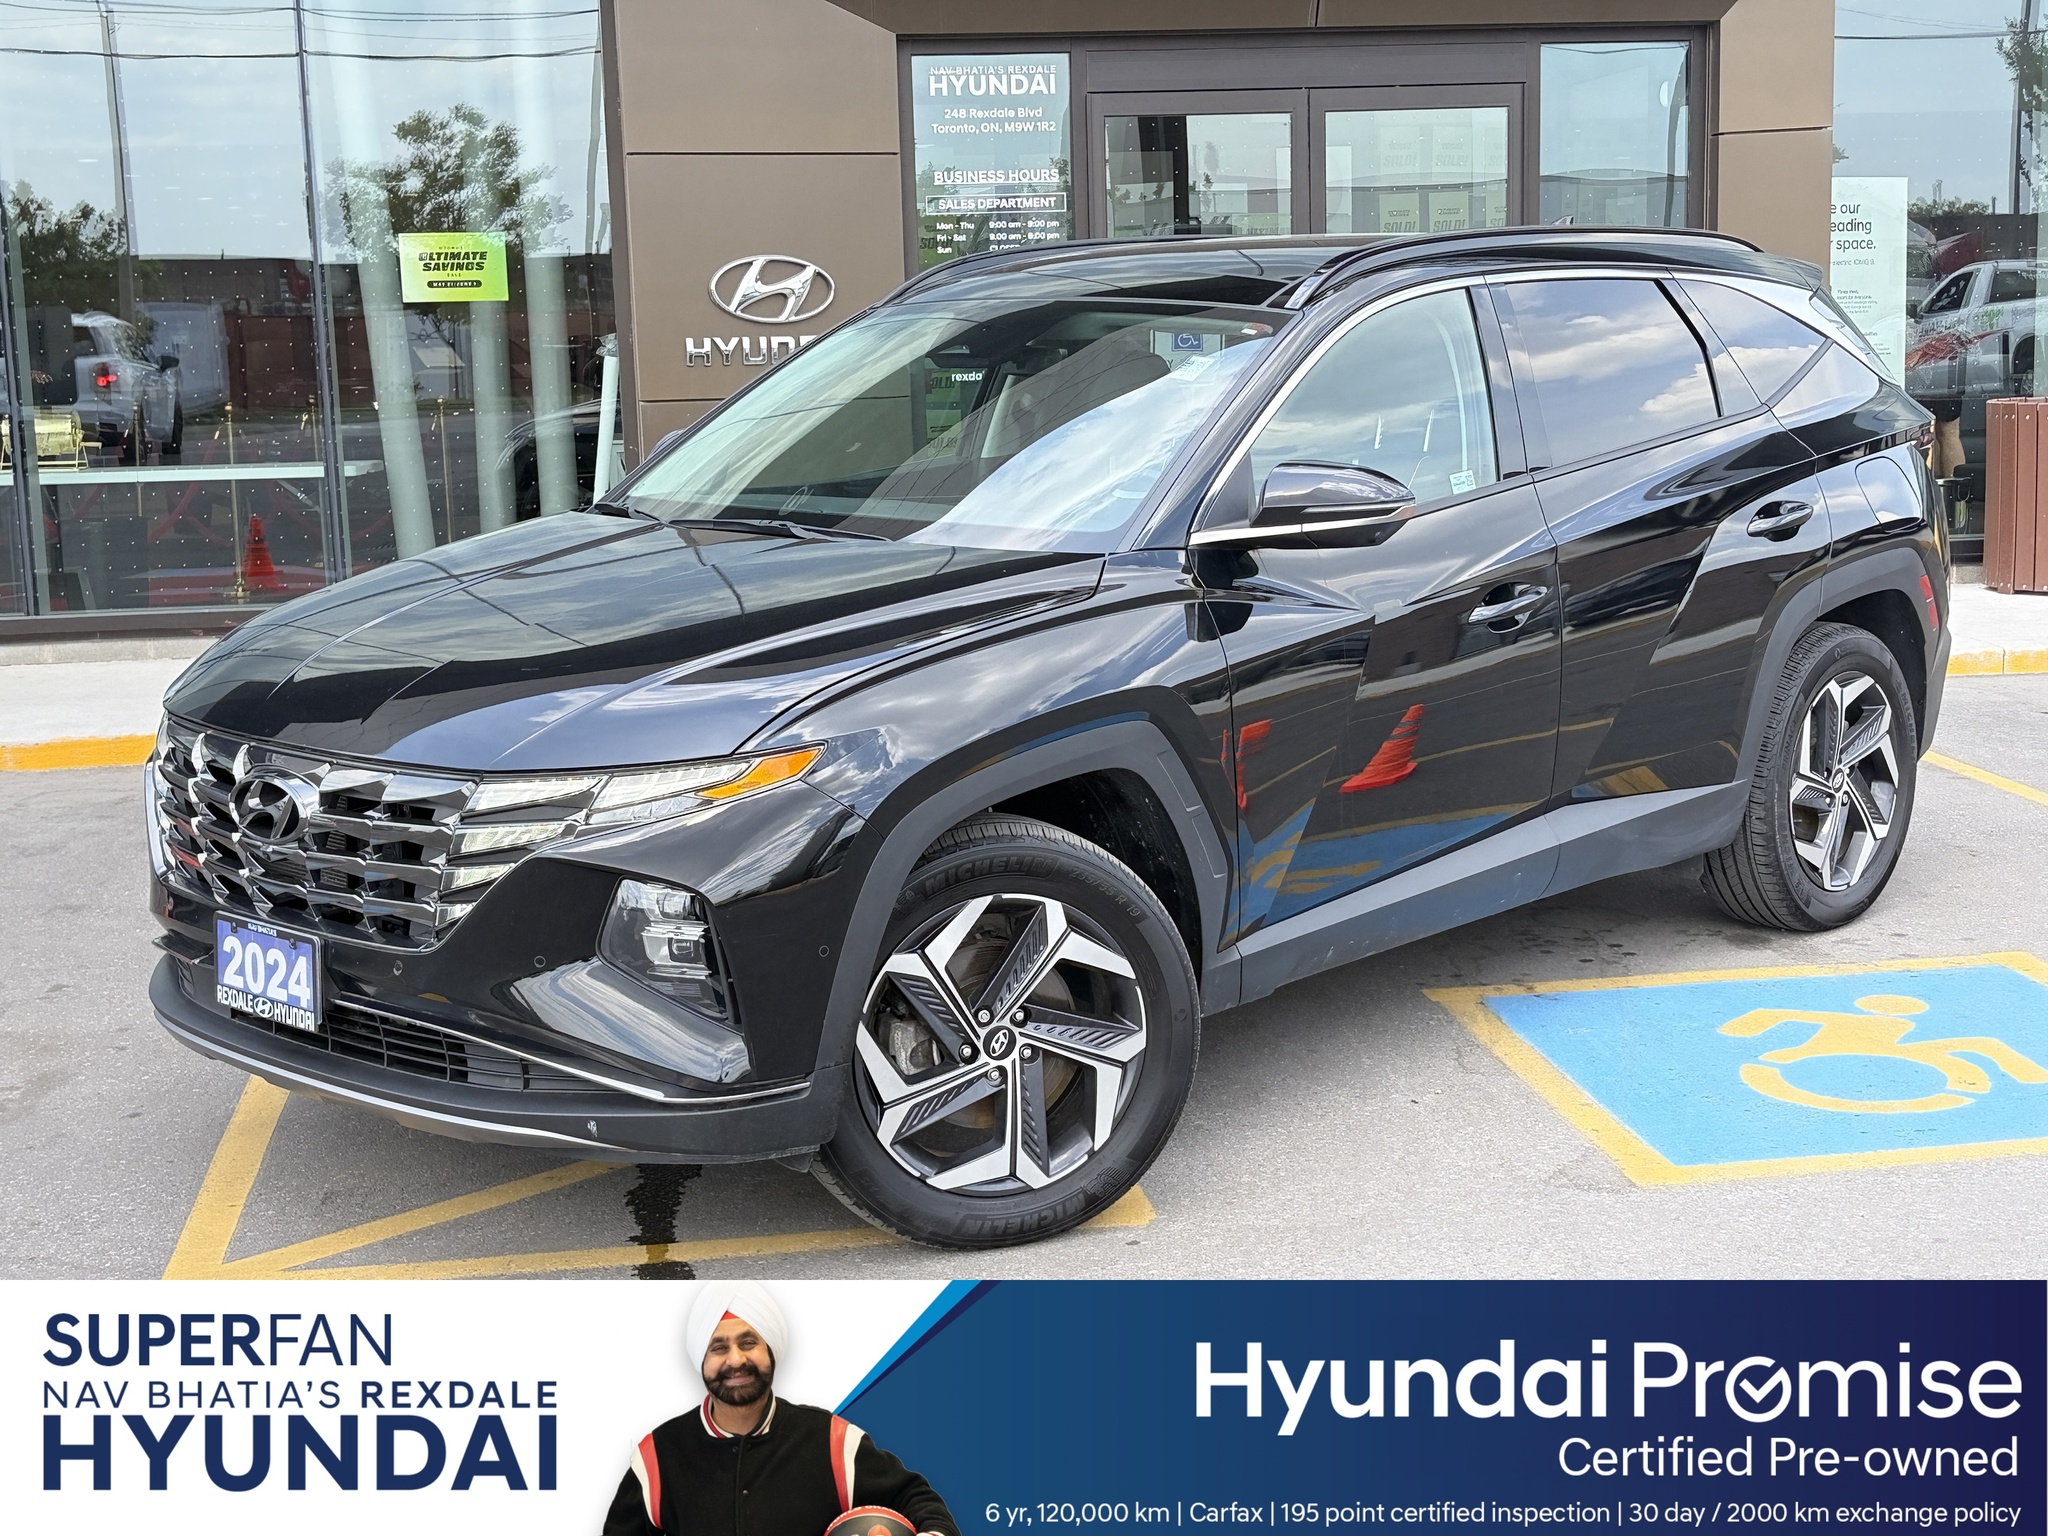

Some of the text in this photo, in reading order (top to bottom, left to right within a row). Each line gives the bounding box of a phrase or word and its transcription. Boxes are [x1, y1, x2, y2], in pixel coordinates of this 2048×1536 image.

[929, 65, 1057, 75] NAV BHATIA'S REXDALE
[929, 73, 1056, 96] HYUNDAI
[944, 107, 1043, 118] 248 Rexdale Blvd
[931, 121, 1056, 134] Toronto, ON, M9W 1R2
[934, 168, 1060, 183] BUSINESS HOURS
[938, 197, 1056, 210] SALES DEPARTMENT
[1840, 204, 1860, 214] our
[937, 222, 954, 230] Mon
[960, 222, 974, 230] Thu
[937, 234, 946, 242] Fri
[1046, 233, 1060, 241] pm
[937, 246, 952, 254] Sun
[1836, 239, 1876, 253] space.
[422, 262, 485, 271] SAVINGS
[924, 854, 1052, 897] MICHELIN
[1126, 903, 1142, 917] 19
[222, 935, 311, 1010] 2024
[217, 984, 315, 1032] REXDALE HYUNDAI
[960, 1192, 1086, 1235] MICHELIN
